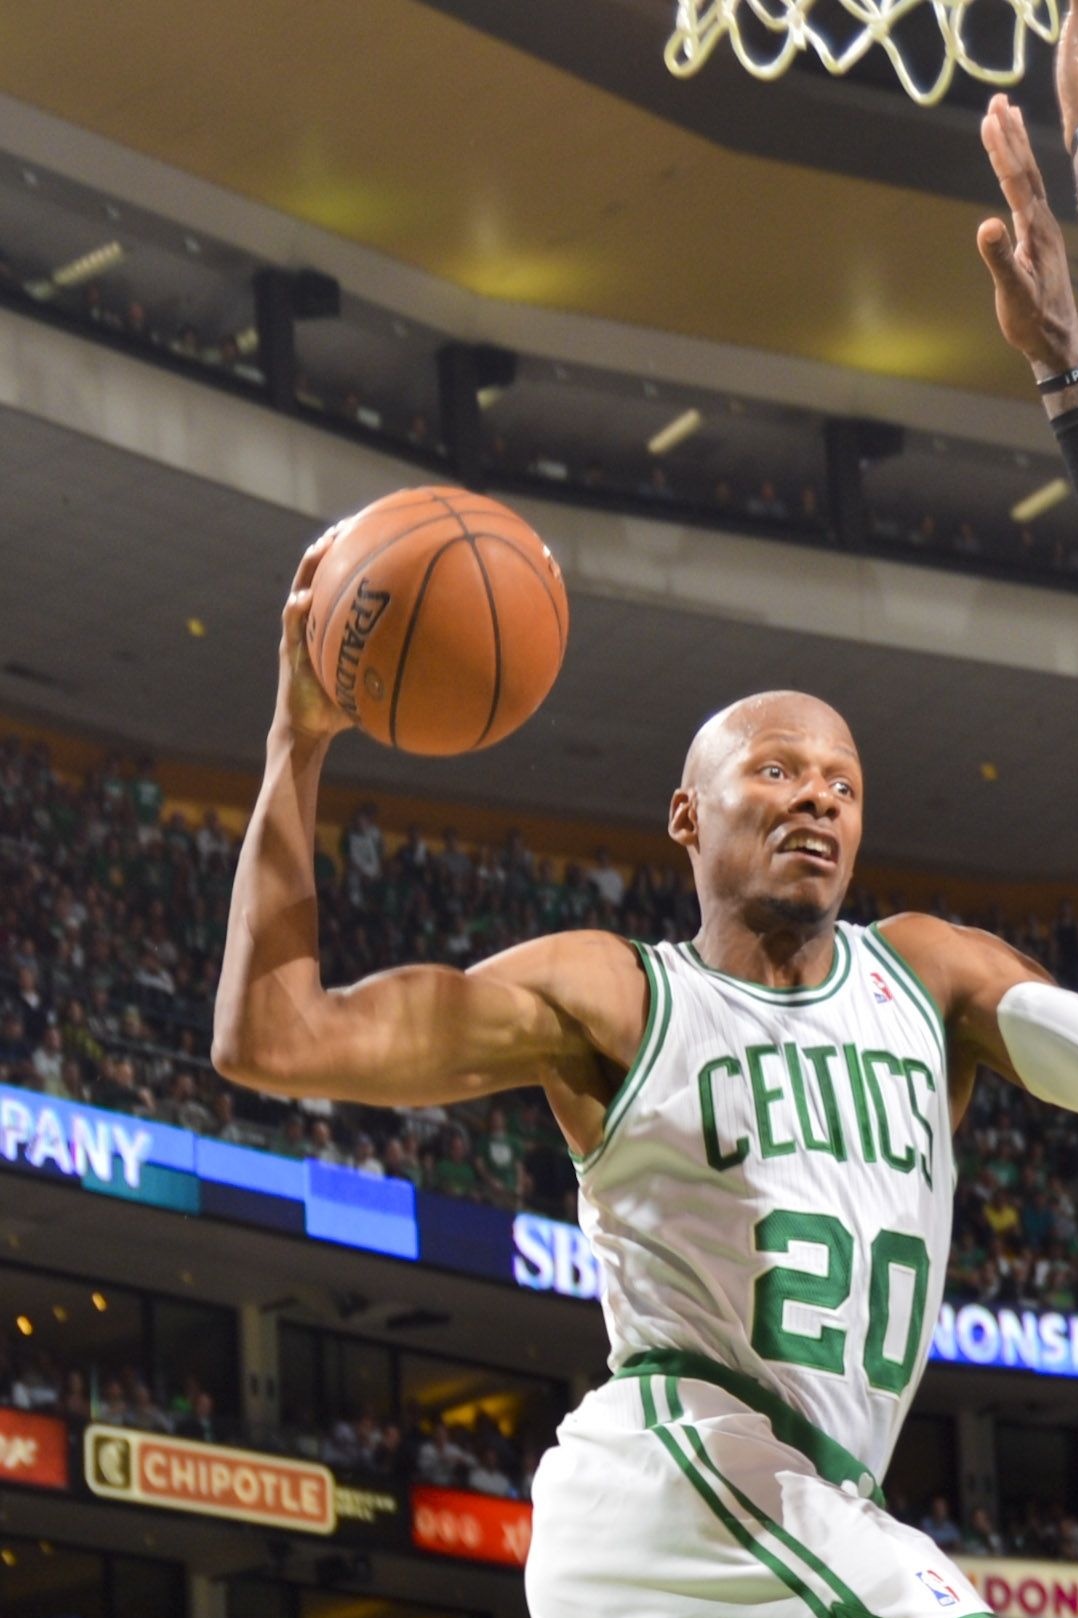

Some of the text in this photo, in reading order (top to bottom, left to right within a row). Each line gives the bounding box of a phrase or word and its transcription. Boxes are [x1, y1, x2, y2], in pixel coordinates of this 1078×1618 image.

[0, 1098, 152, 1189] PANY
[697, 1042, 937, 1192] CELTICS
[513, 1212, 606, 1300] SB
[751, 1208, 930, 1399] 20
[143, 1451, 323, 1516] CHIPOTLE
